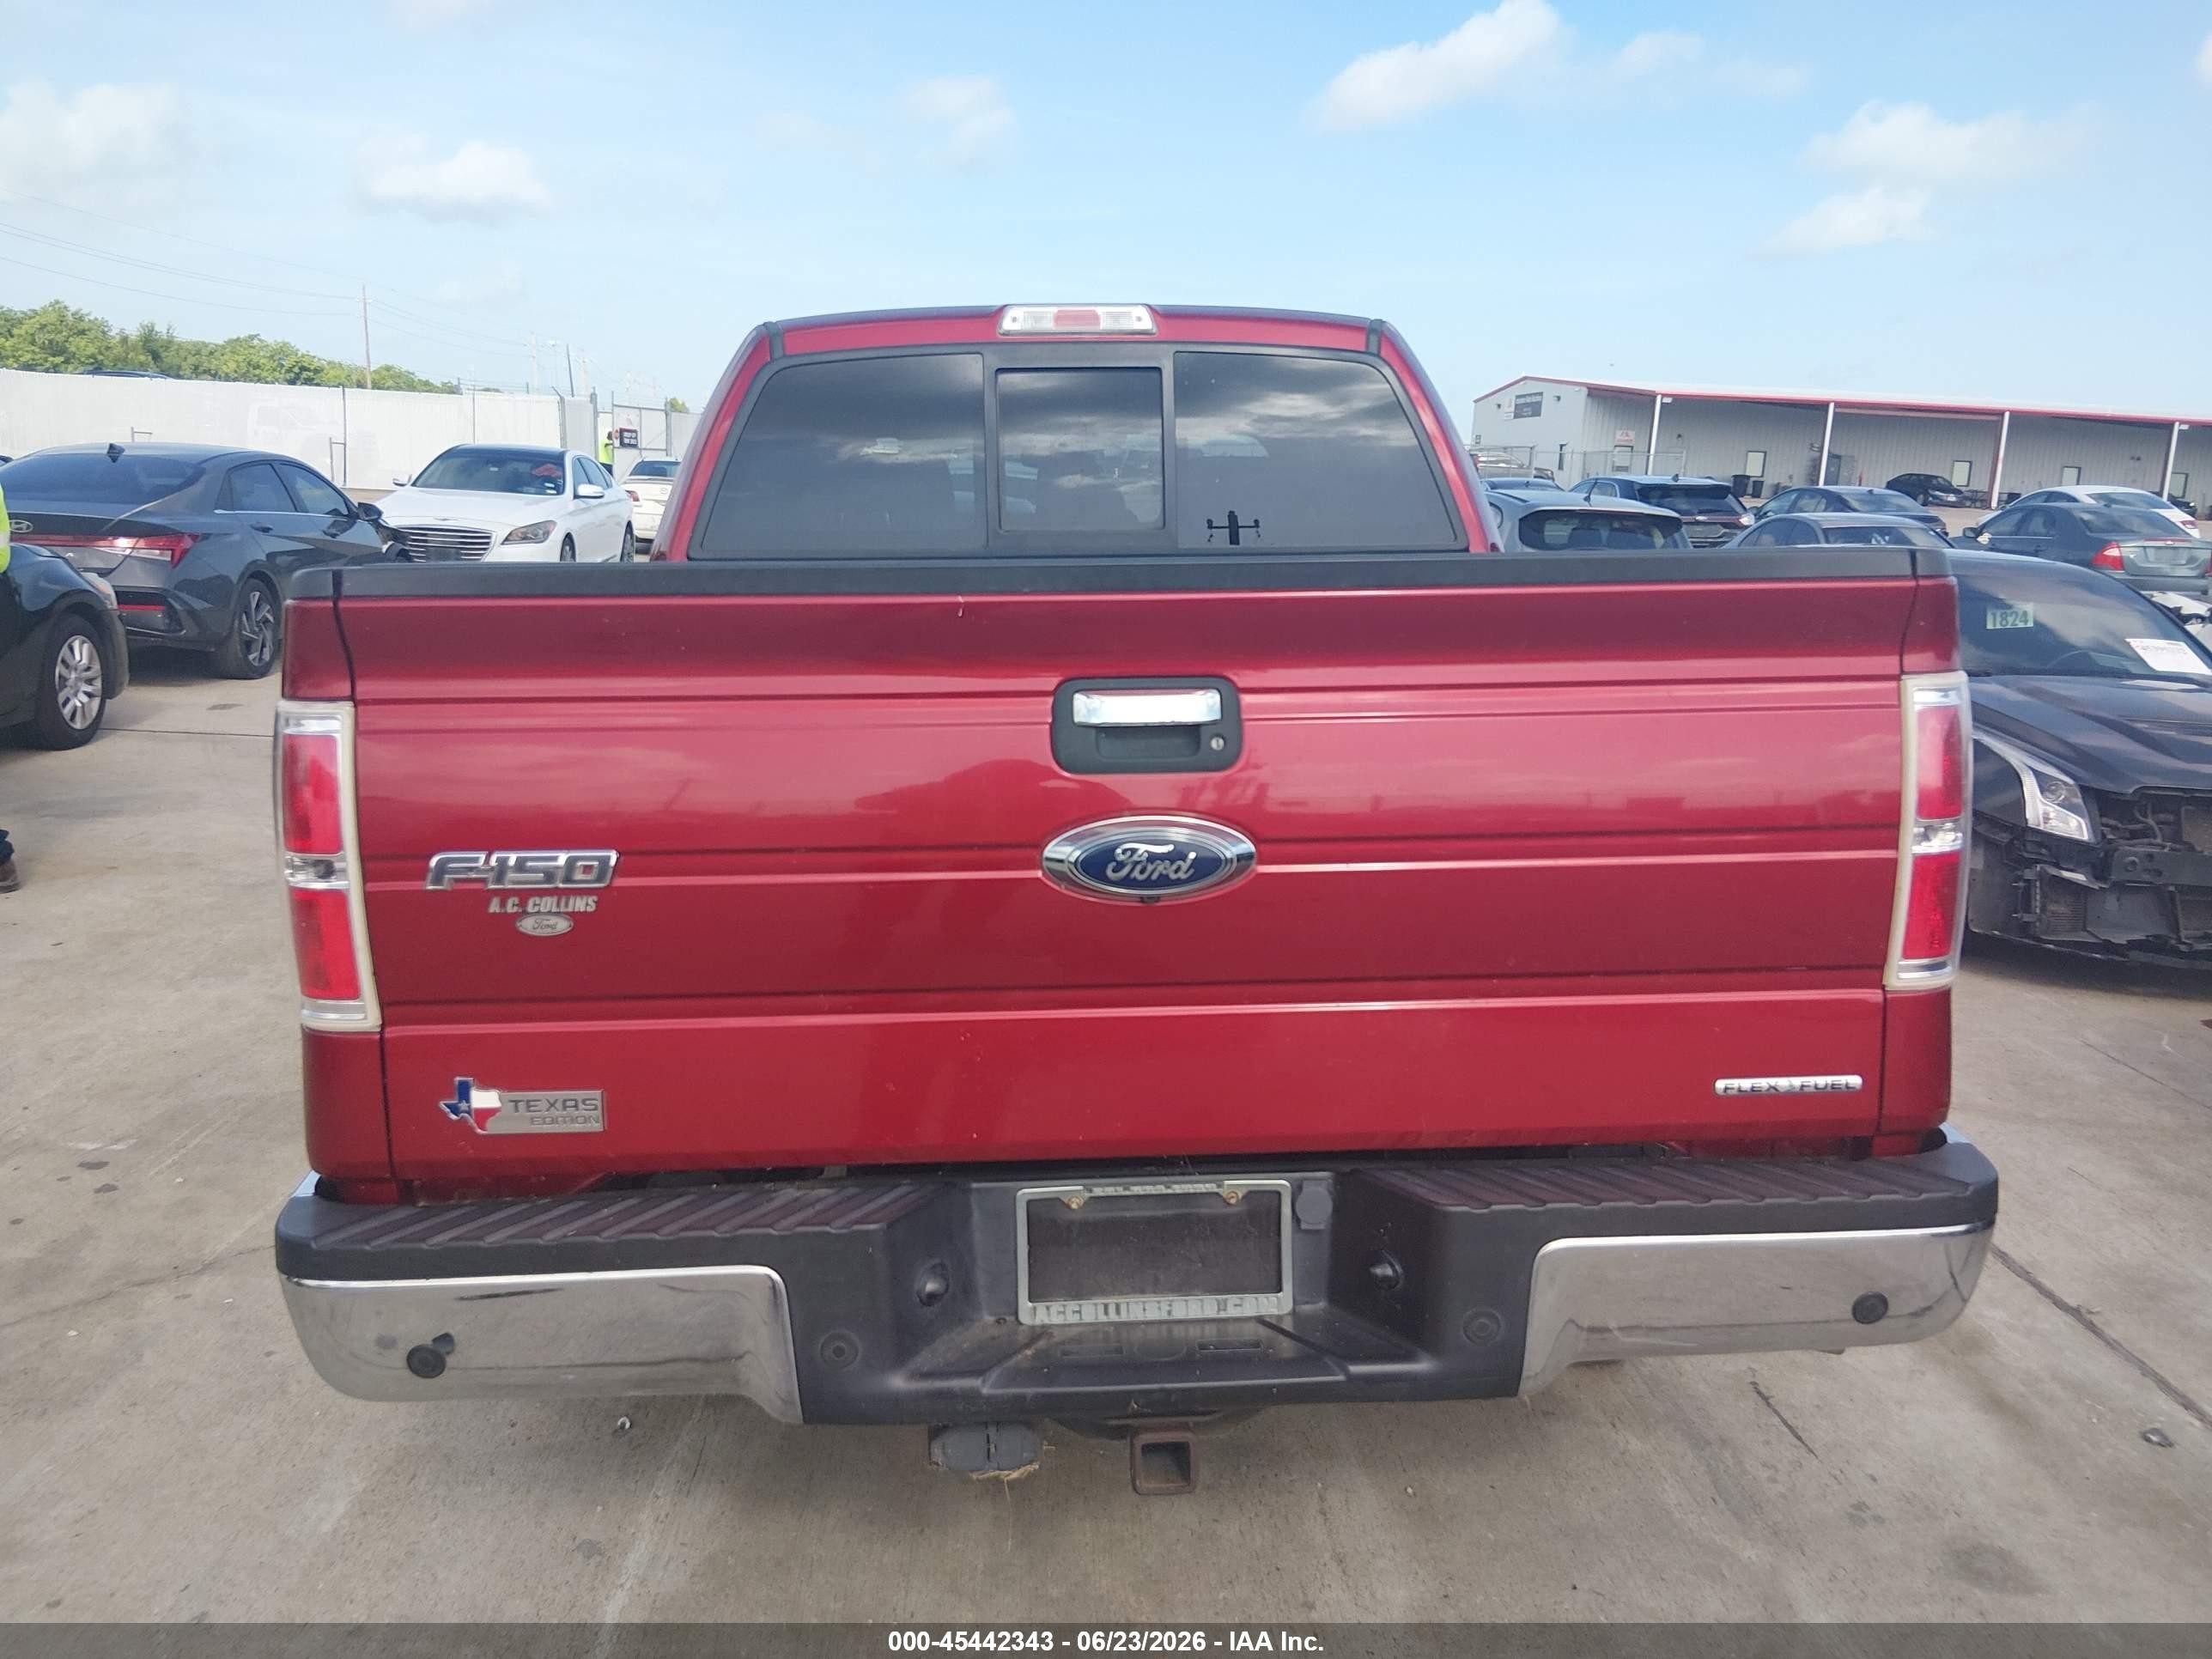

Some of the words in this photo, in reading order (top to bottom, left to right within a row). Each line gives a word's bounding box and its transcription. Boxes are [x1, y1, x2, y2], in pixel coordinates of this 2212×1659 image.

[1990, 610, 2029, 628] 1824
[425, 848, 620, 890] F-150
[1106, 842, 1197, 881] Ford
[488, 896, 522, 914] A.C.
[526, 895, 598, 913] COLLINS
[530, 918, 558, 931] Ford
[1723, 1082, 1780, 1093] FLEX
[1798, 1079, 1857, 1091] FUEL
[508, 1097, 599, 1114] TEXAS
[530, 1115, 599, 1127] EDITION
